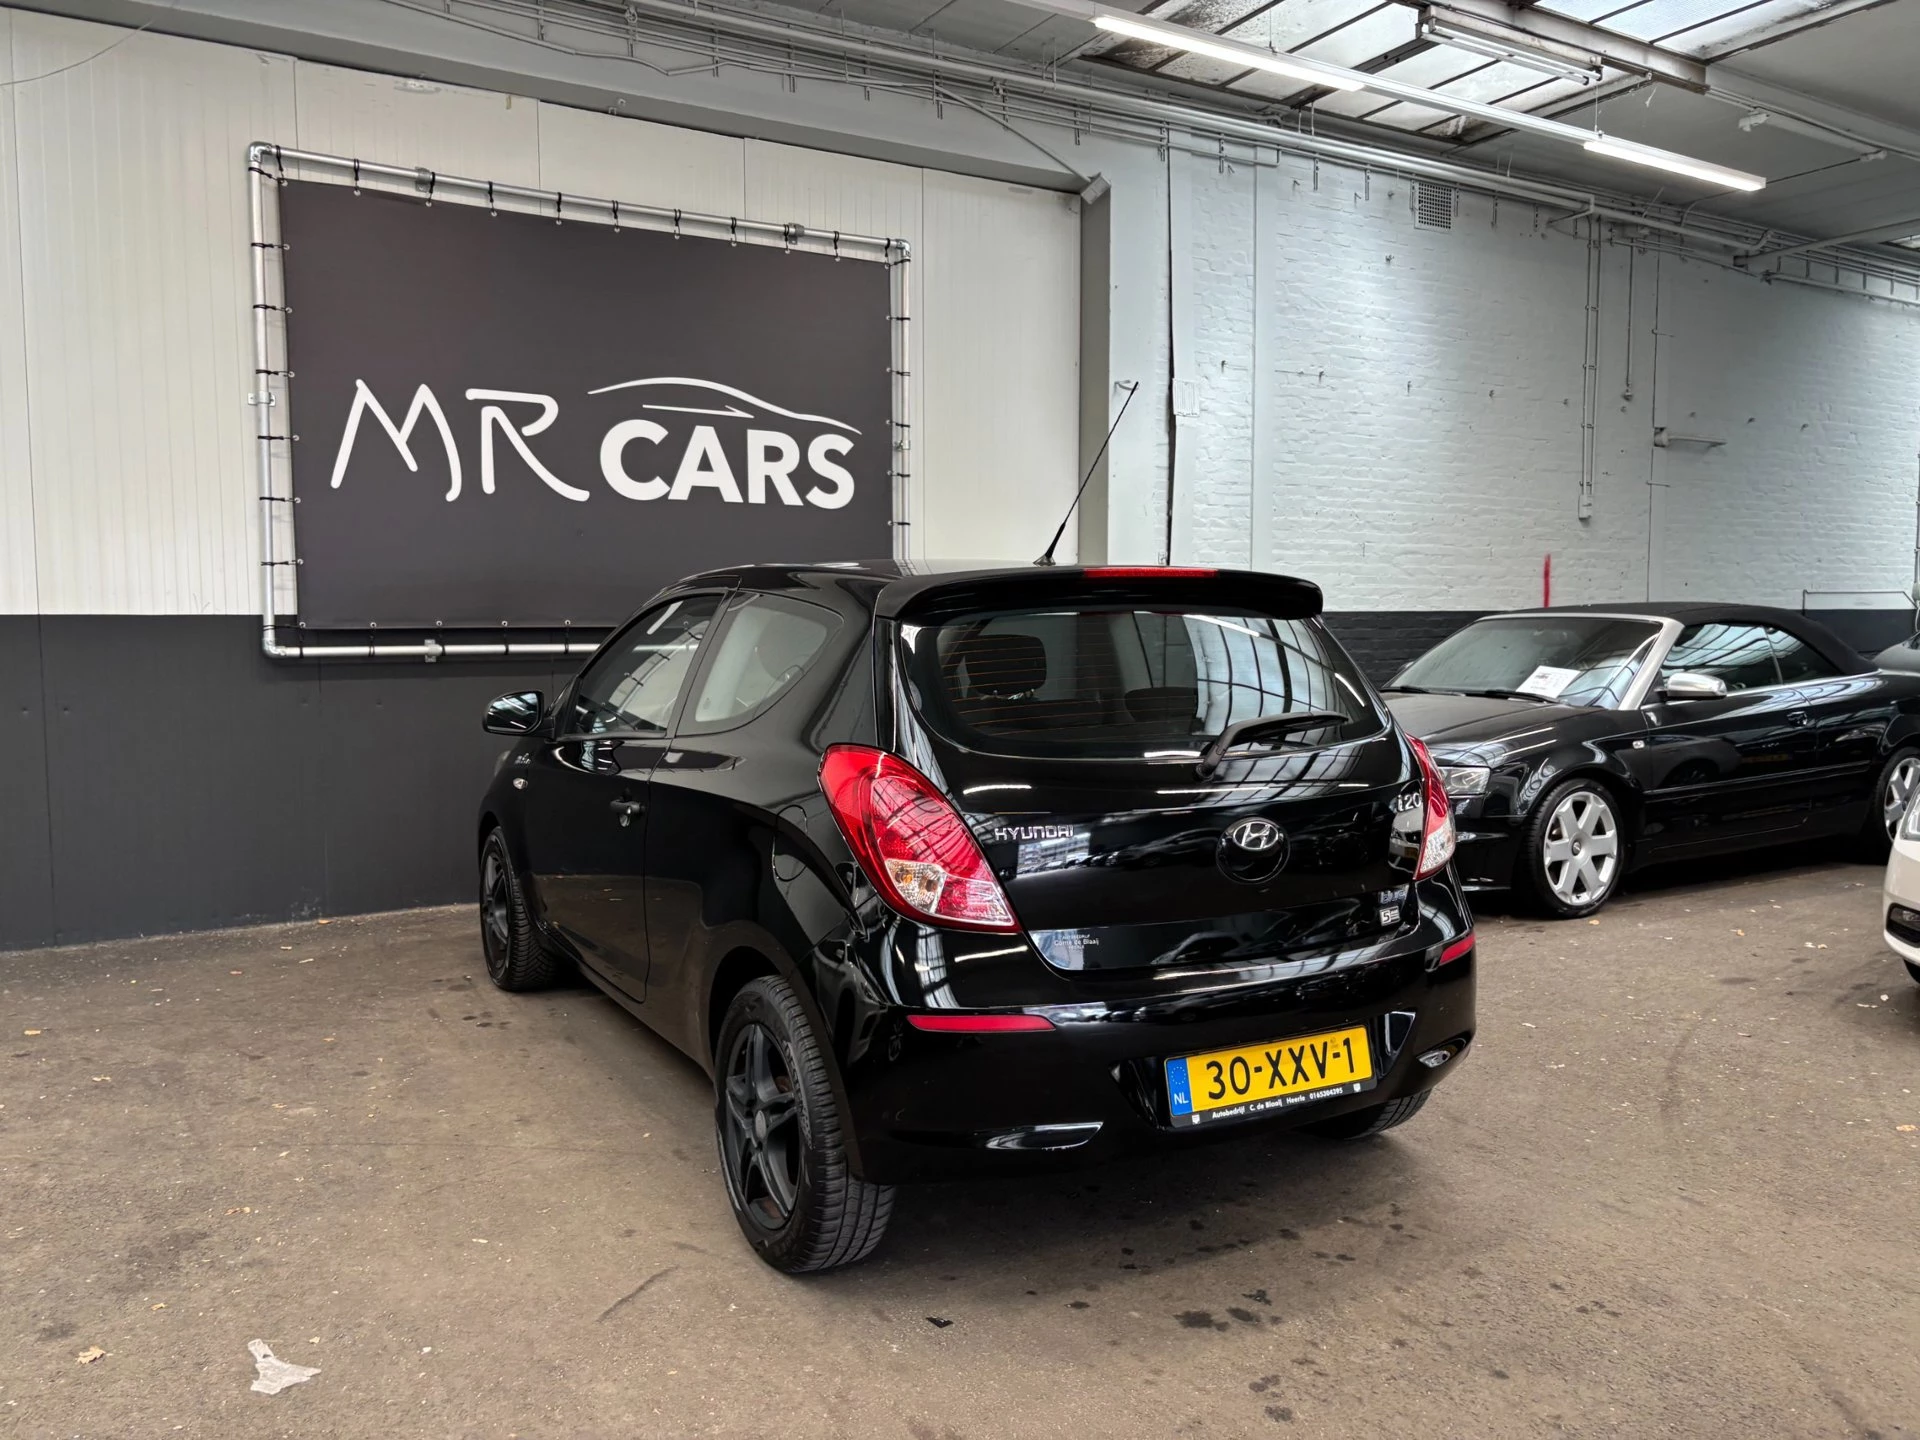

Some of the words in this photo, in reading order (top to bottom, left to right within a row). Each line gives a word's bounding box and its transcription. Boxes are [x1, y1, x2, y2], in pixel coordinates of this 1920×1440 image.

[330, 378, 589, 502] MR
[599, 418, 856, 511] CARS
[994, 825, 1074, 841] HYUNDAI
[1206, 1037, 1355, 1100] 30-XXV-1
[1174, 1092, 1189, 1105] NL
[1256, 1102, 1264, 1110] de
